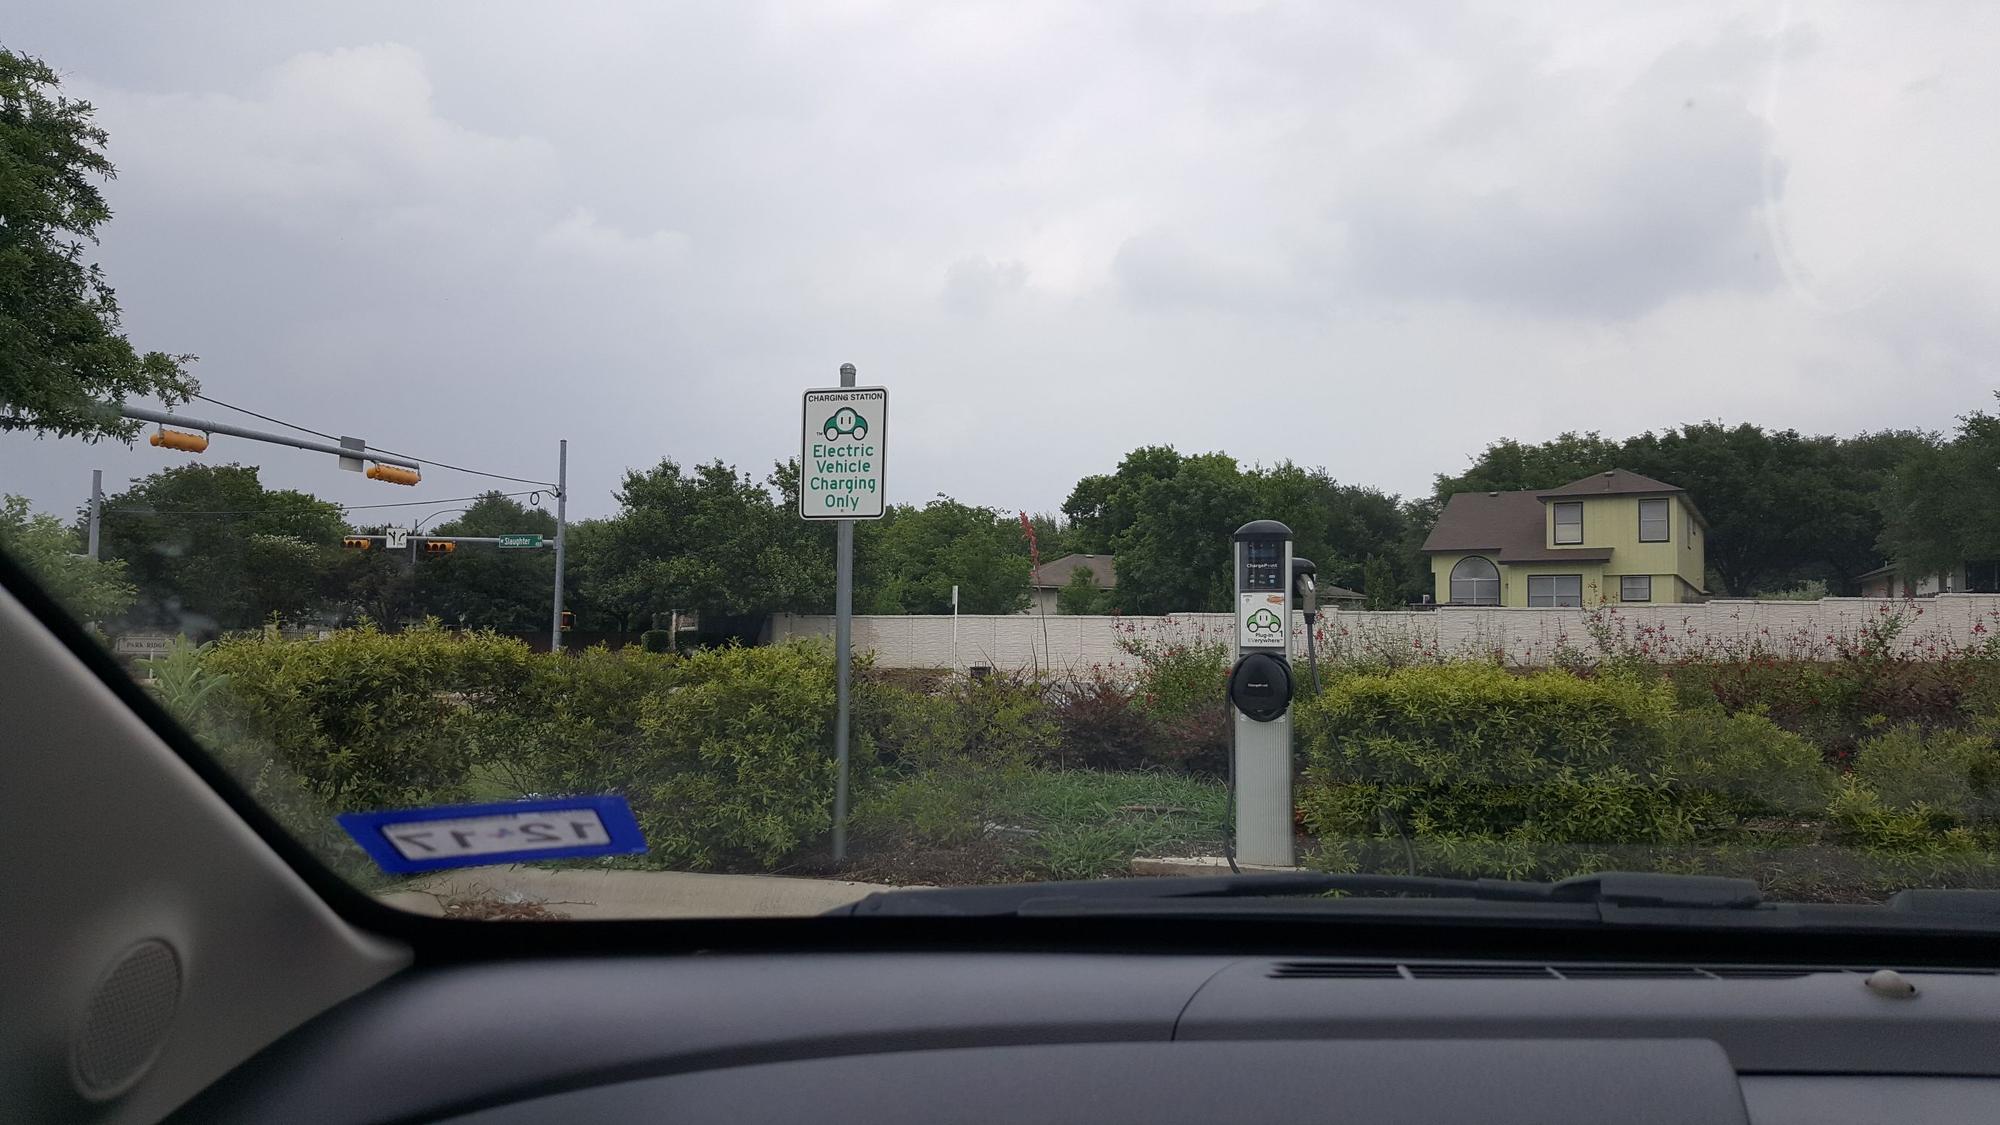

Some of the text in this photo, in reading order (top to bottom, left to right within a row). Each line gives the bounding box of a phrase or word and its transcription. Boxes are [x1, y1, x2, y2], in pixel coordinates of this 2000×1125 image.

[808, 393, 883, 402] CHARGING STATION
[813, 444, 874, 458] Electric
[816, 460, 871, 473] Vehicle
[810, 476, 876, 494] Charging
[825, 494, 860, 511] Only
[505, 537, 531, 546] Slaughter
[1279, 630, 1284, 638] 1
